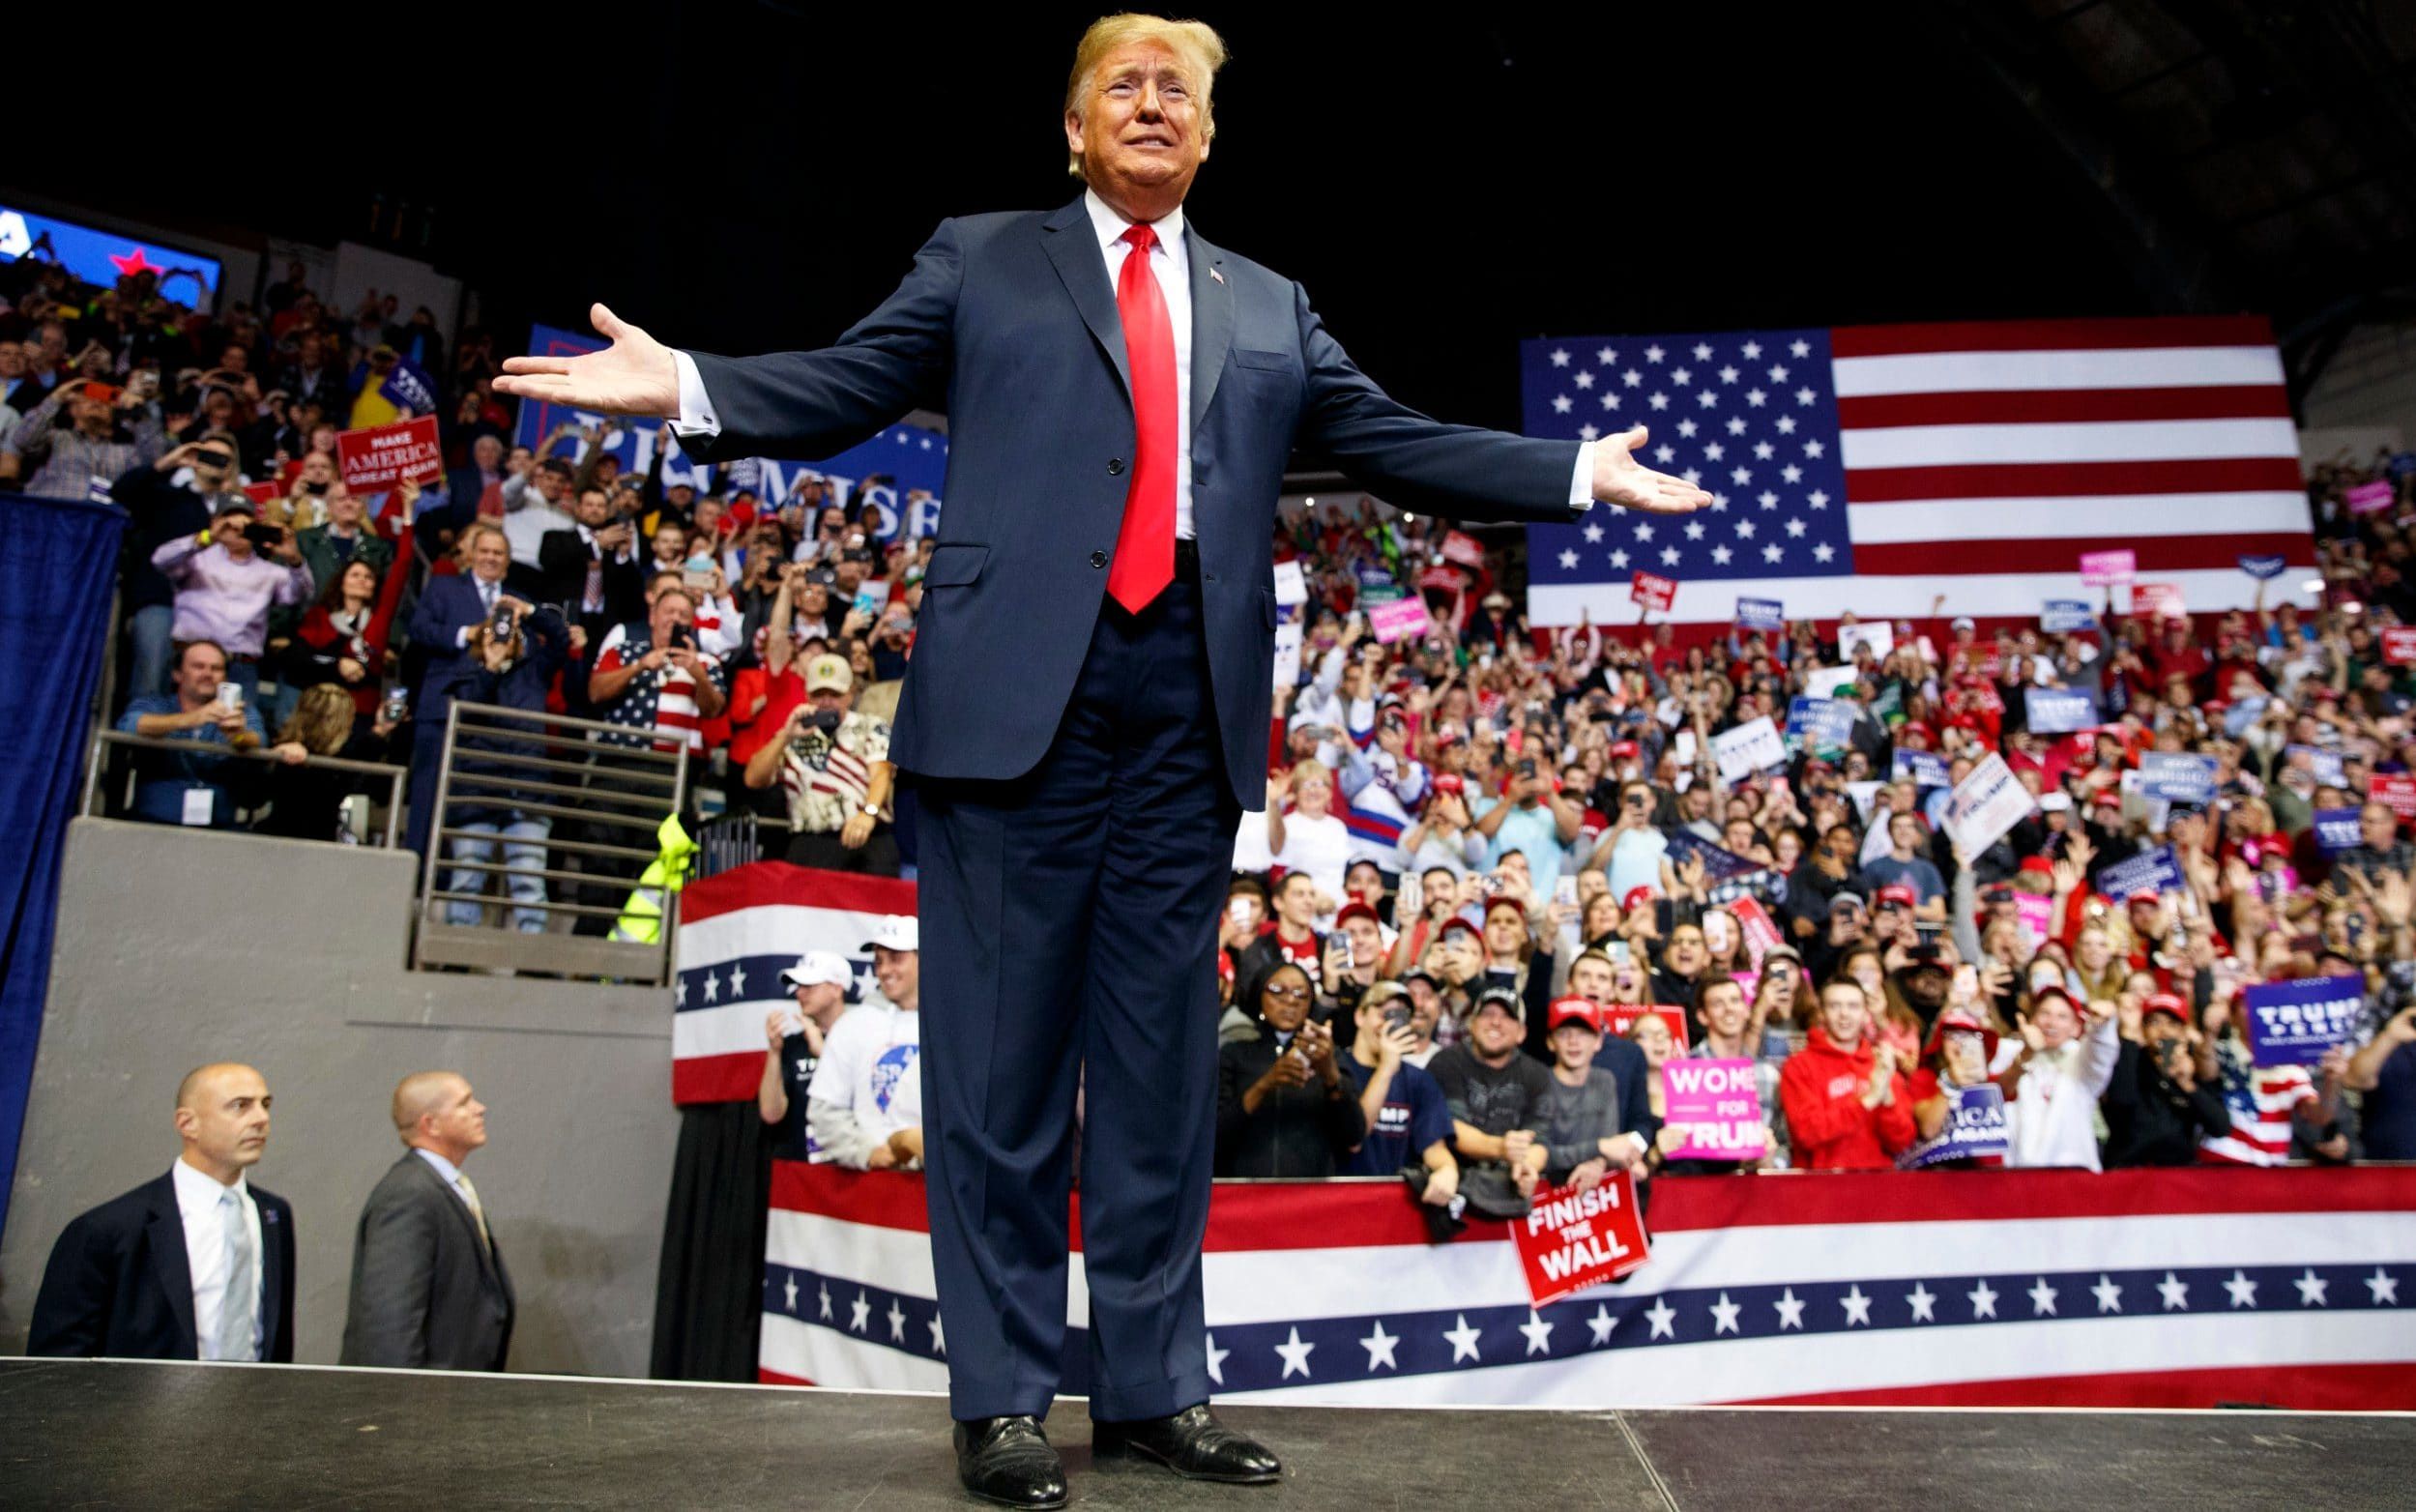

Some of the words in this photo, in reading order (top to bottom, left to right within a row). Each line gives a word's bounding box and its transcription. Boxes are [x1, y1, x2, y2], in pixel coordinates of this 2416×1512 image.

[370, 431, 413, 450] MAKE
[347, 441, 438, 473] AMERICA
[1716, 1099, 1749, 1117] FOR
[1527, 1181, 1620, 1237] FINISH
[1558, 1219, 1594, 1244] THE
[1538, 1230, 1630, 1282] WALL
